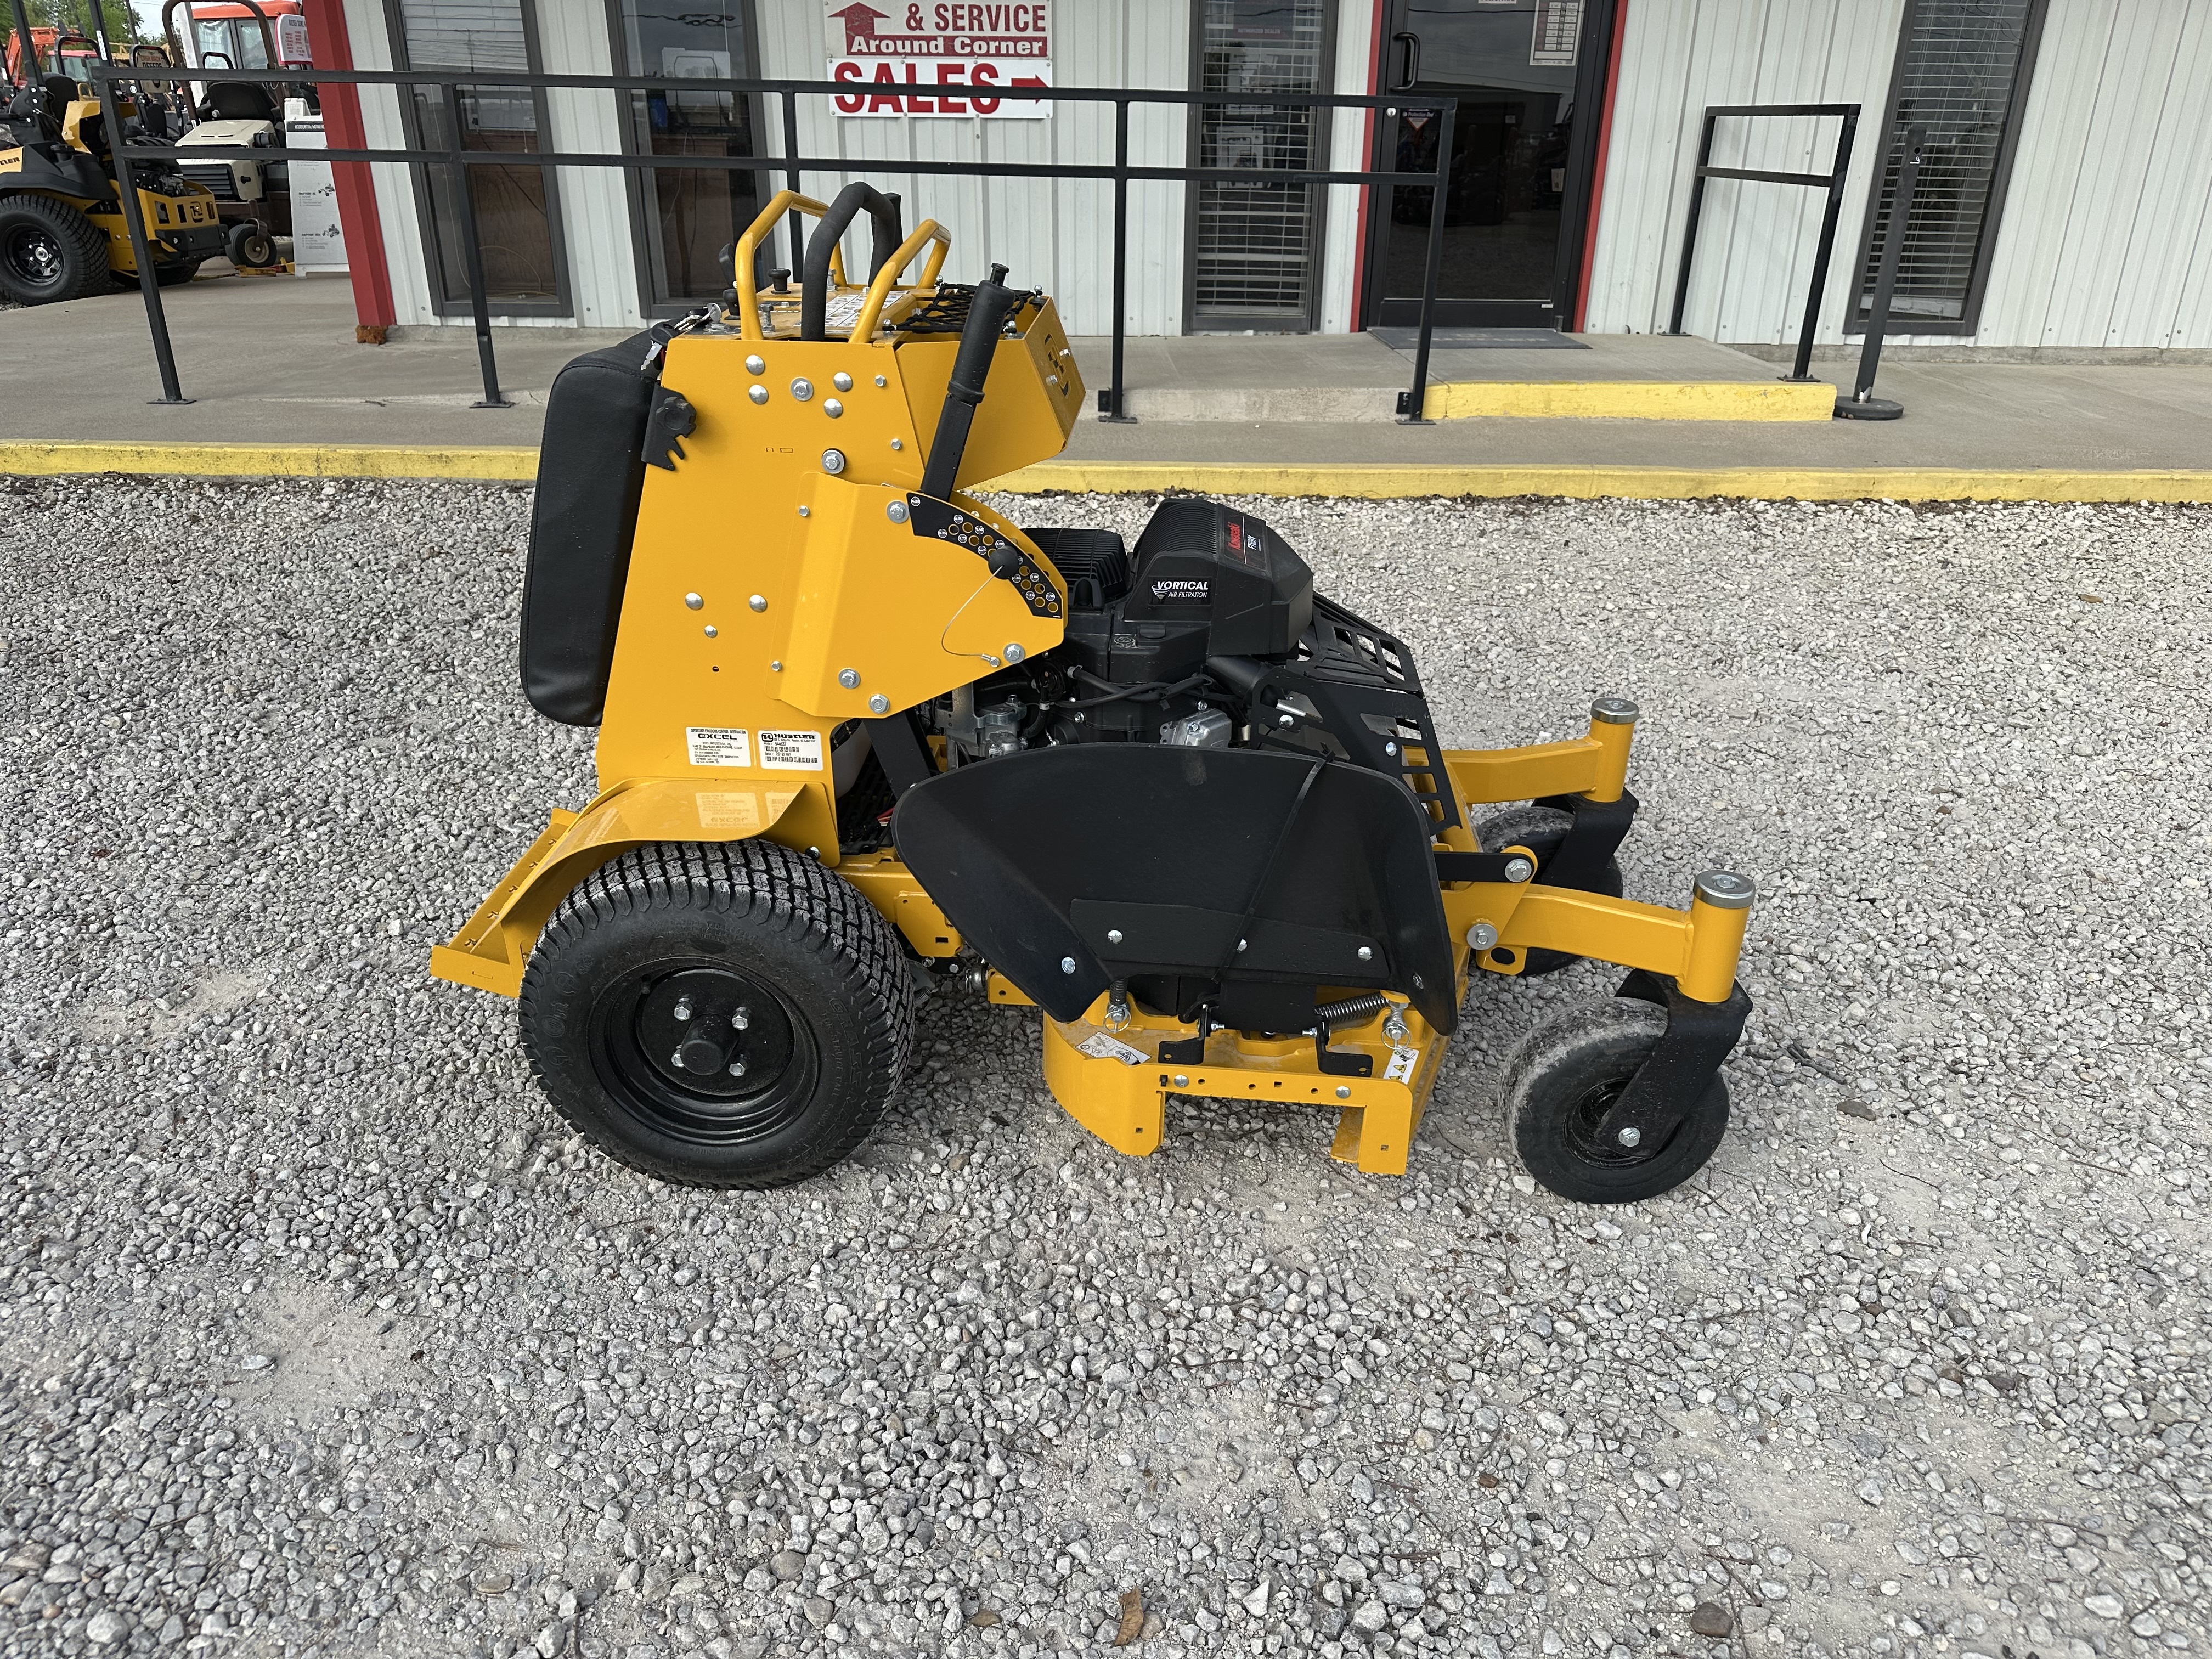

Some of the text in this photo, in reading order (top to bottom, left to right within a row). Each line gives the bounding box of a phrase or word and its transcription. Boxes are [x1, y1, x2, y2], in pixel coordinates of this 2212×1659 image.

[906, 3, 1046, 32] & SERVICE
[851, 36, 1042, 54] Around Corner
[834, 62, 1001, 114] SALES
[1157, 581, 1209, 590] VORTICAL
[829, 998, 862, 1086] GRASS
[831, 1035, 843, 1071] SERVICE
[832, 1076, 842, 1096] CALL
